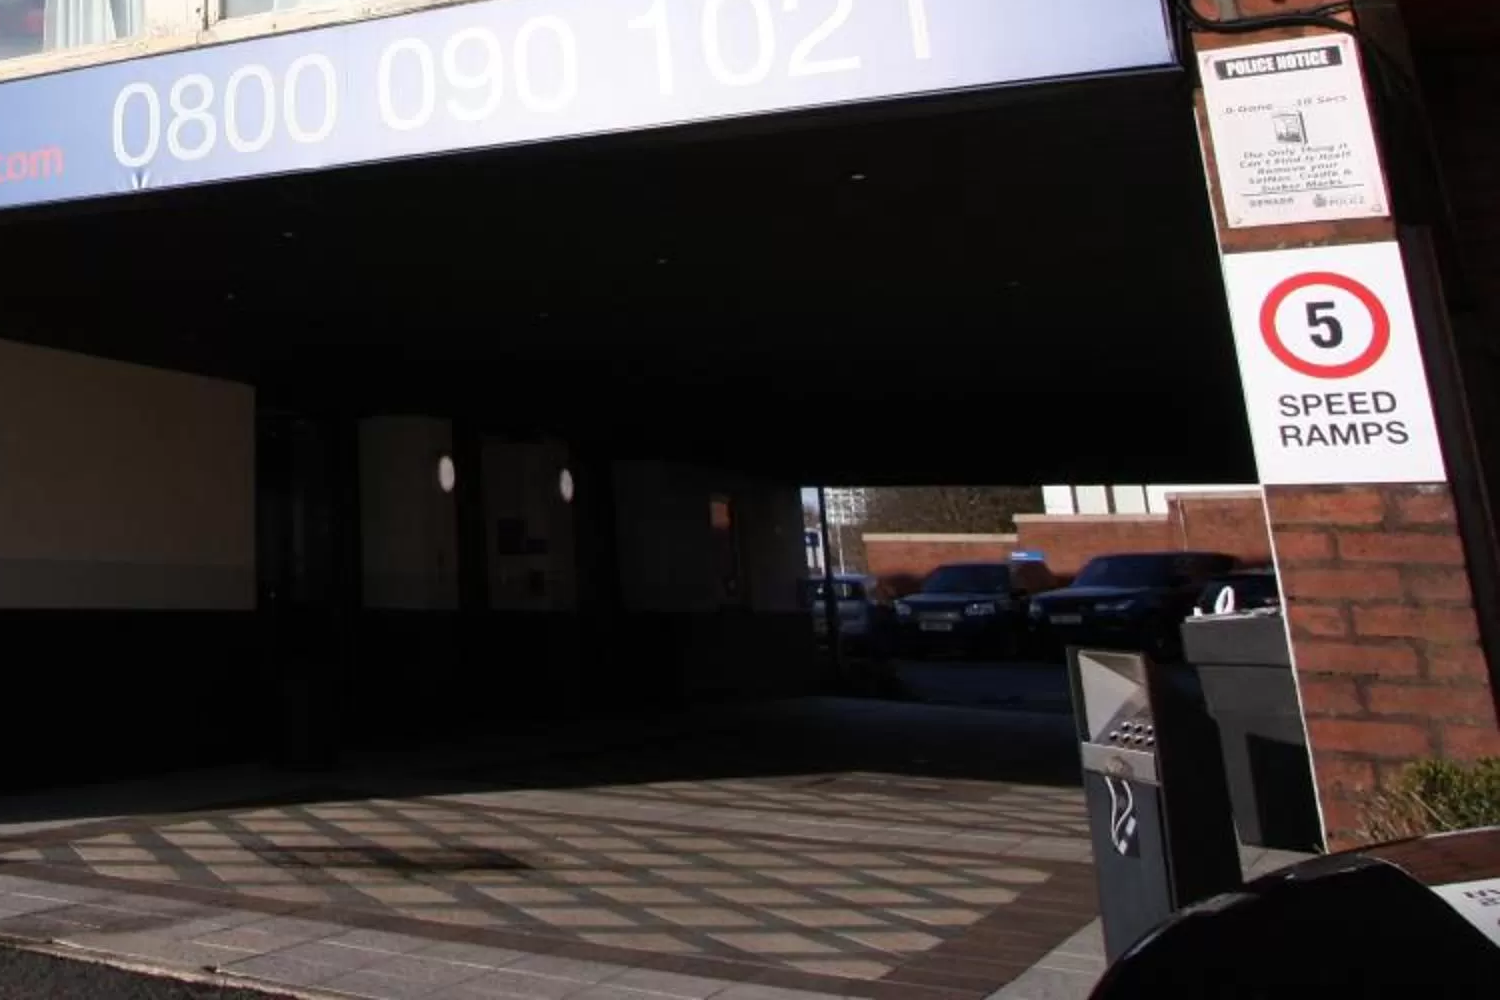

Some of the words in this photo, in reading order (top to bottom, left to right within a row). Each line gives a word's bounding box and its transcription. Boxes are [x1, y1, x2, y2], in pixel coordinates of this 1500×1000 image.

[1226, 55, 1275, 77] POLICE
[1276, 49, 1331, 71] NOTICE
[111, 52, 338, 168] 0800
[377, 15, 578, 132] 090
[1305, 300, 1344, 349] 5
[1278, 390, 1398, 417] SPEED
[1279, 420, 1410, 448] RAMPS
